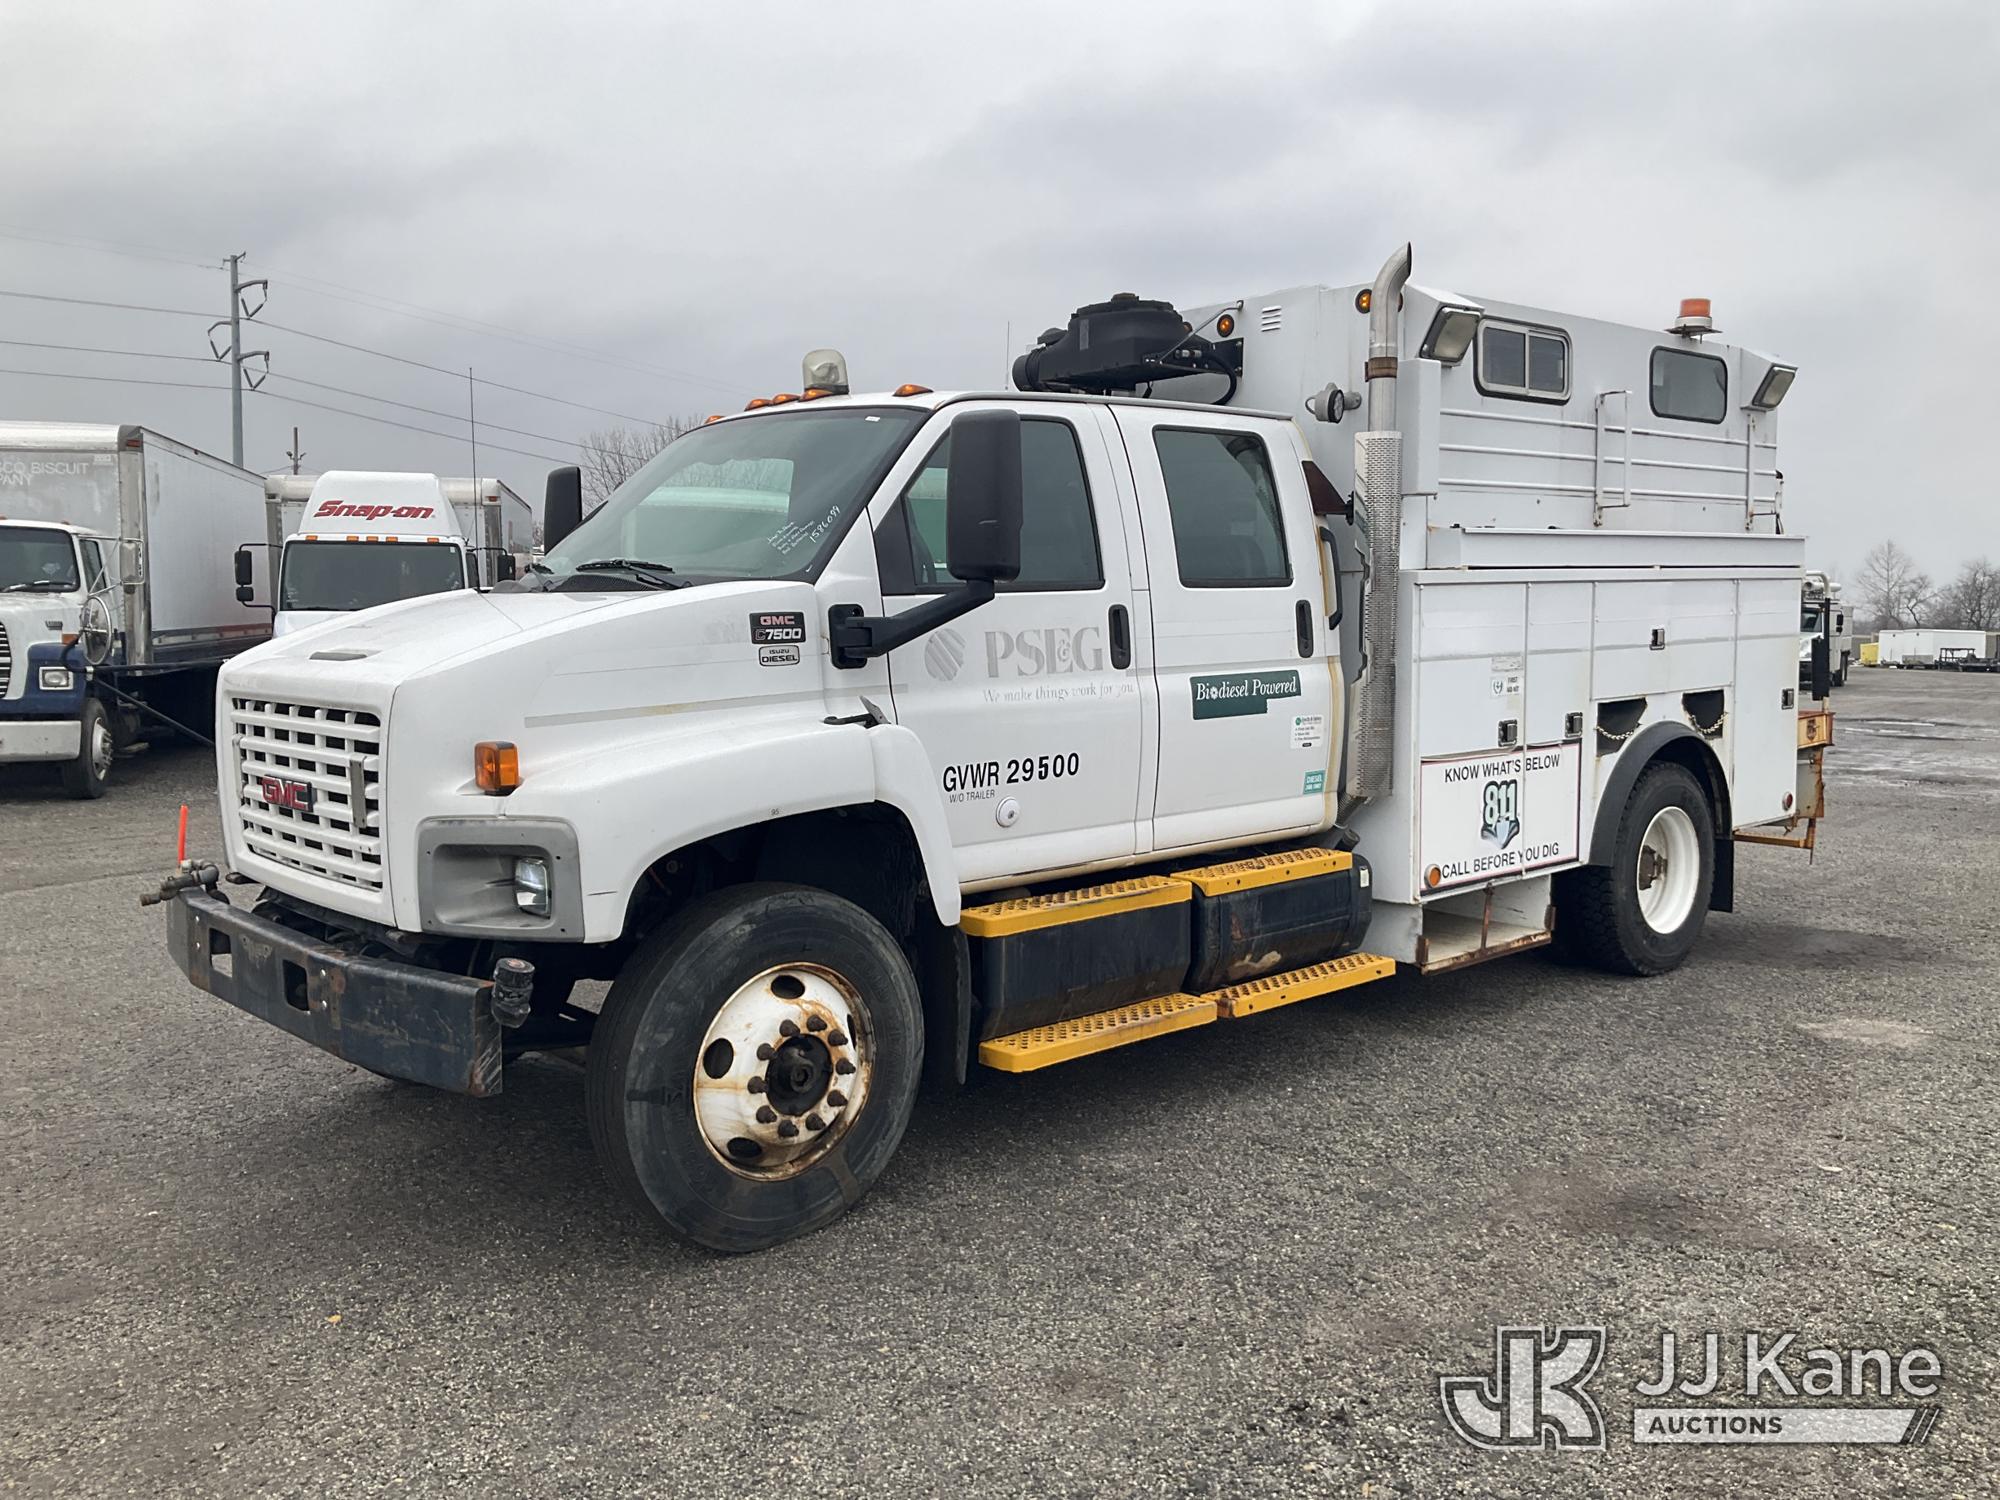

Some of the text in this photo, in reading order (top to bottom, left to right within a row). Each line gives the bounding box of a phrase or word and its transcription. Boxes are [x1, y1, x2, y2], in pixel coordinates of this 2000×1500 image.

[0, 461, 89, 475] CO BISCUIT
[313, 499, 435, 521] Snap-on
[809, 505, 840, 543] 1586099
[760, 615, 795, 626] GMC
[755, 628, 802, 641] C7500
[761, 654, 798, 663] DIESEL
[1003, 687, 1033, 702] make
[1035, 684, 1070, 701] things
[1196, 676, 1298, 701] Biodiesel Powered
[943, 752, 1080, 792] GVWR 29500
[1444, 753, 1561, 783] KNOW WHAT'S BELOW
[262, 776, 309, 811] GMC
[949, 789, 996, 804] W/O TRAILER
[1483, 779, 1518, 828] 811
[1442, 843, 1560, 879] CALL BEFORE YOU DIG
